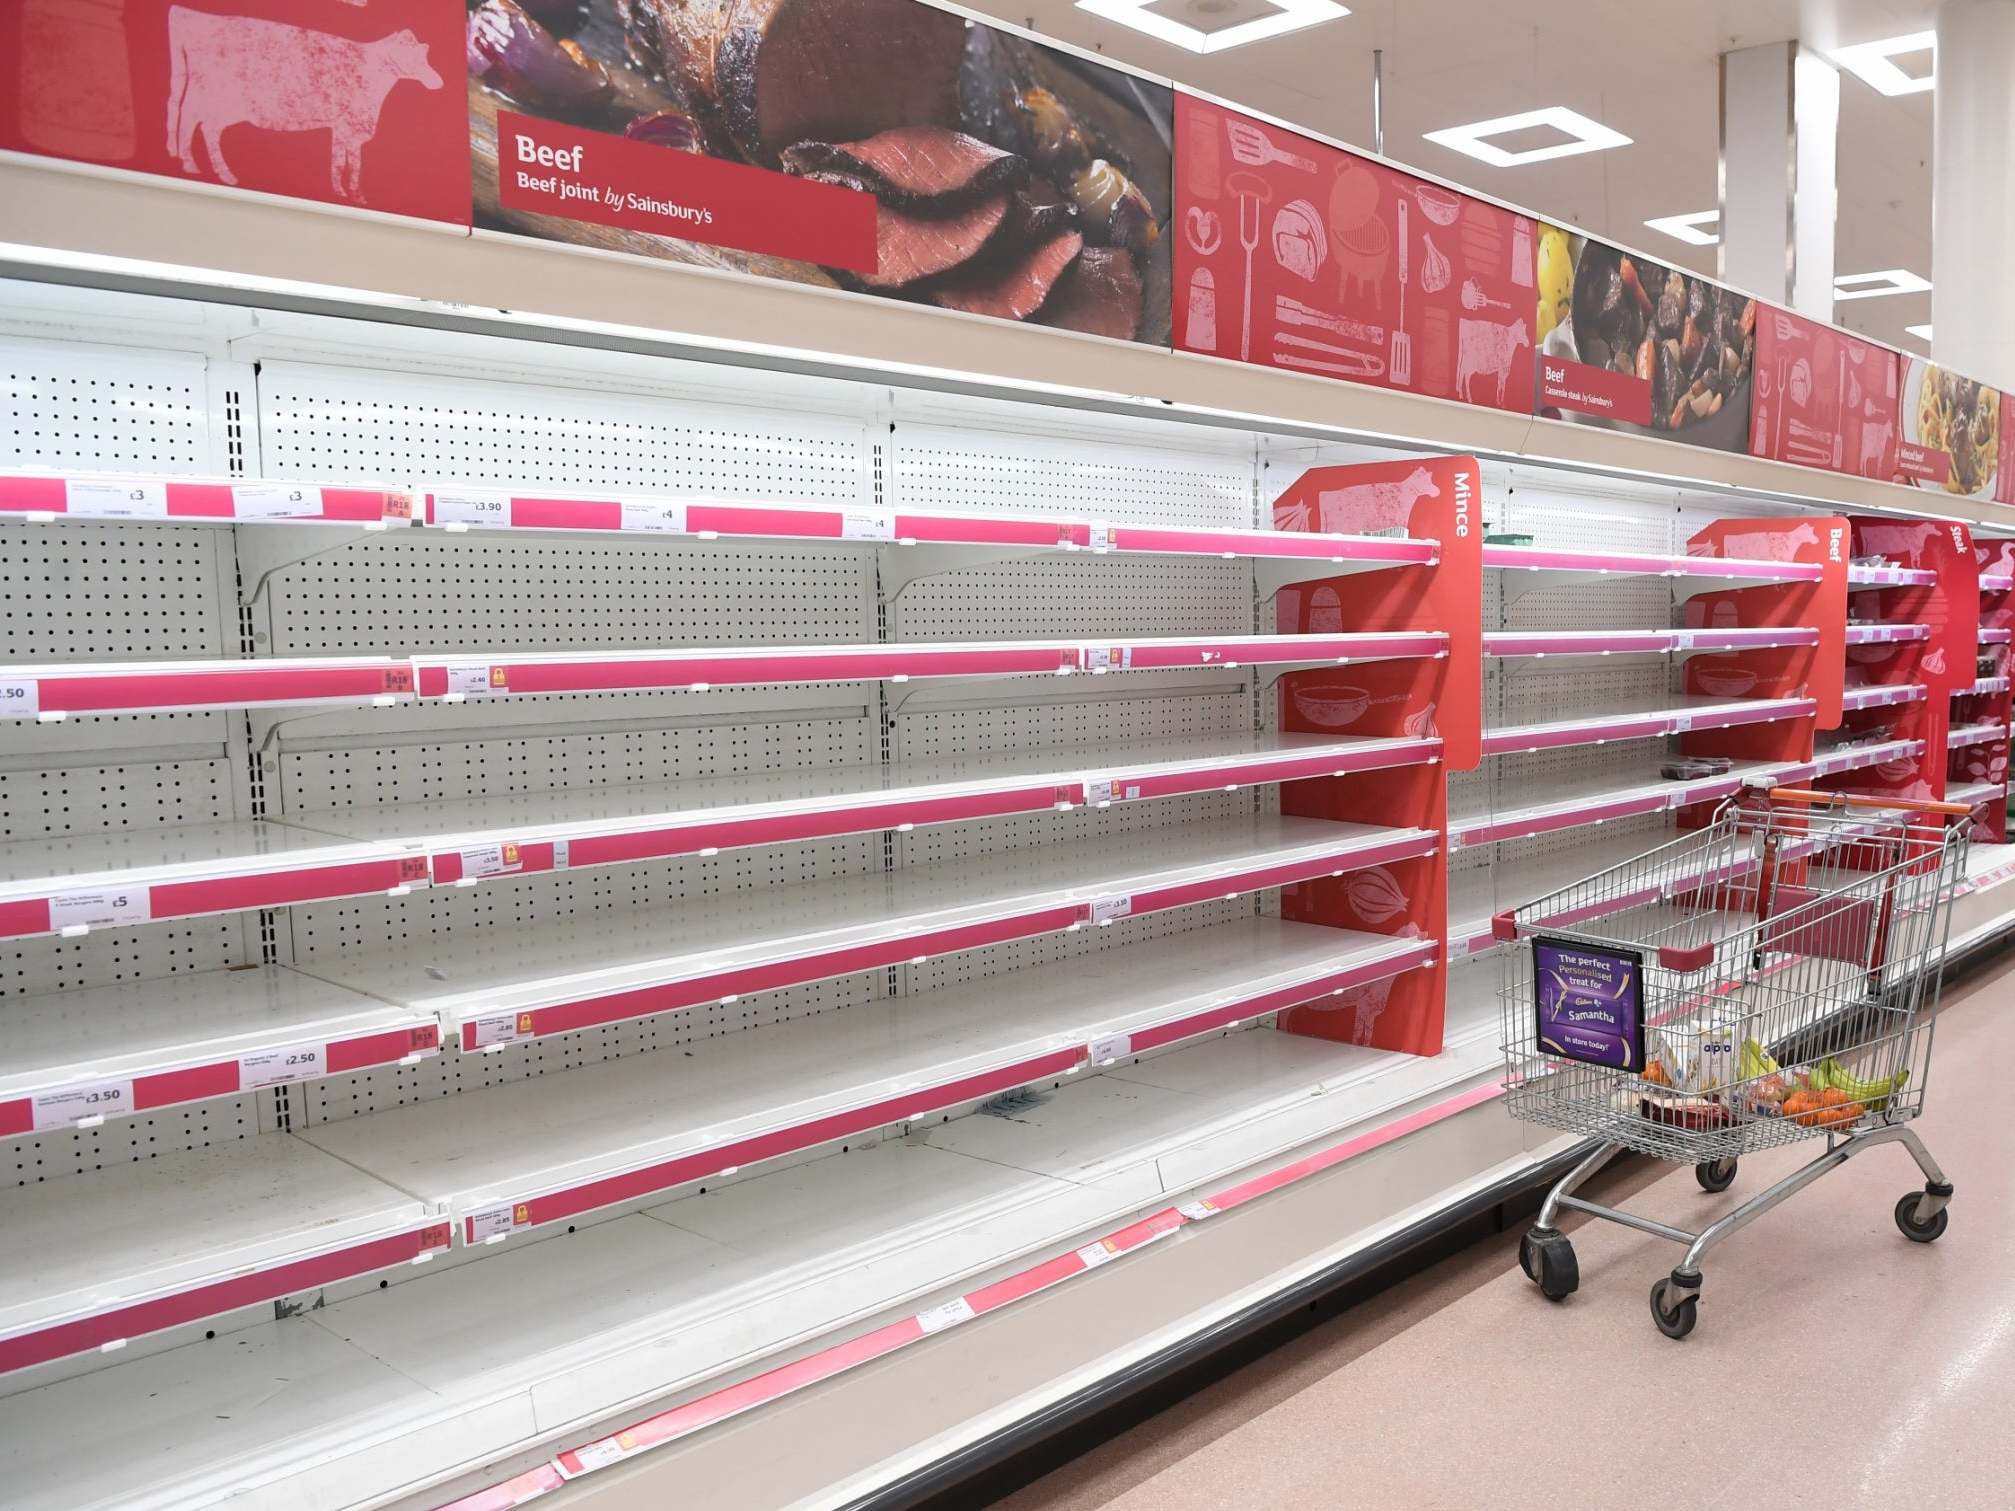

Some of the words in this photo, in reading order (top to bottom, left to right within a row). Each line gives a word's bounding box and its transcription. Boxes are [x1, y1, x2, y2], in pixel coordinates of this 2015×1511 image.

[515, 134, 584, 173] Beef
[516, 171, 557, 195] Beef
[560, 180, 601, 202] joint
[604, 187, 626, 212] by
[627, 193, 713, 225] Sainsbury's
[1545, 366, 1565, 384] Beef
[130, 489, 145, 501] £3
[289, 491, 303, 502] £3
[1454, 472, 1472, 538] Mince
[1830, 527, 1843, 564] Beef
[1950, 524, 1968, 555] Steak
[112, 896, 128, 908] £5
[1558, 953, 1577, 964] The
[1578, 957, 1611, 971] perfect
[1559, 964, 1612, 983] Personalised
[1569, 976, 1589, 988] treat
[1590, 982, 1603, 990] for
[1568, 1010, 1616, 1024] Samantha
[1564, 1035, 1571, 1044] In
[1572, 1037, 1588, 1049] store
[286, 1053, 316, 1066] £2.50
[85, 1089, 121, 1104] £3.50
